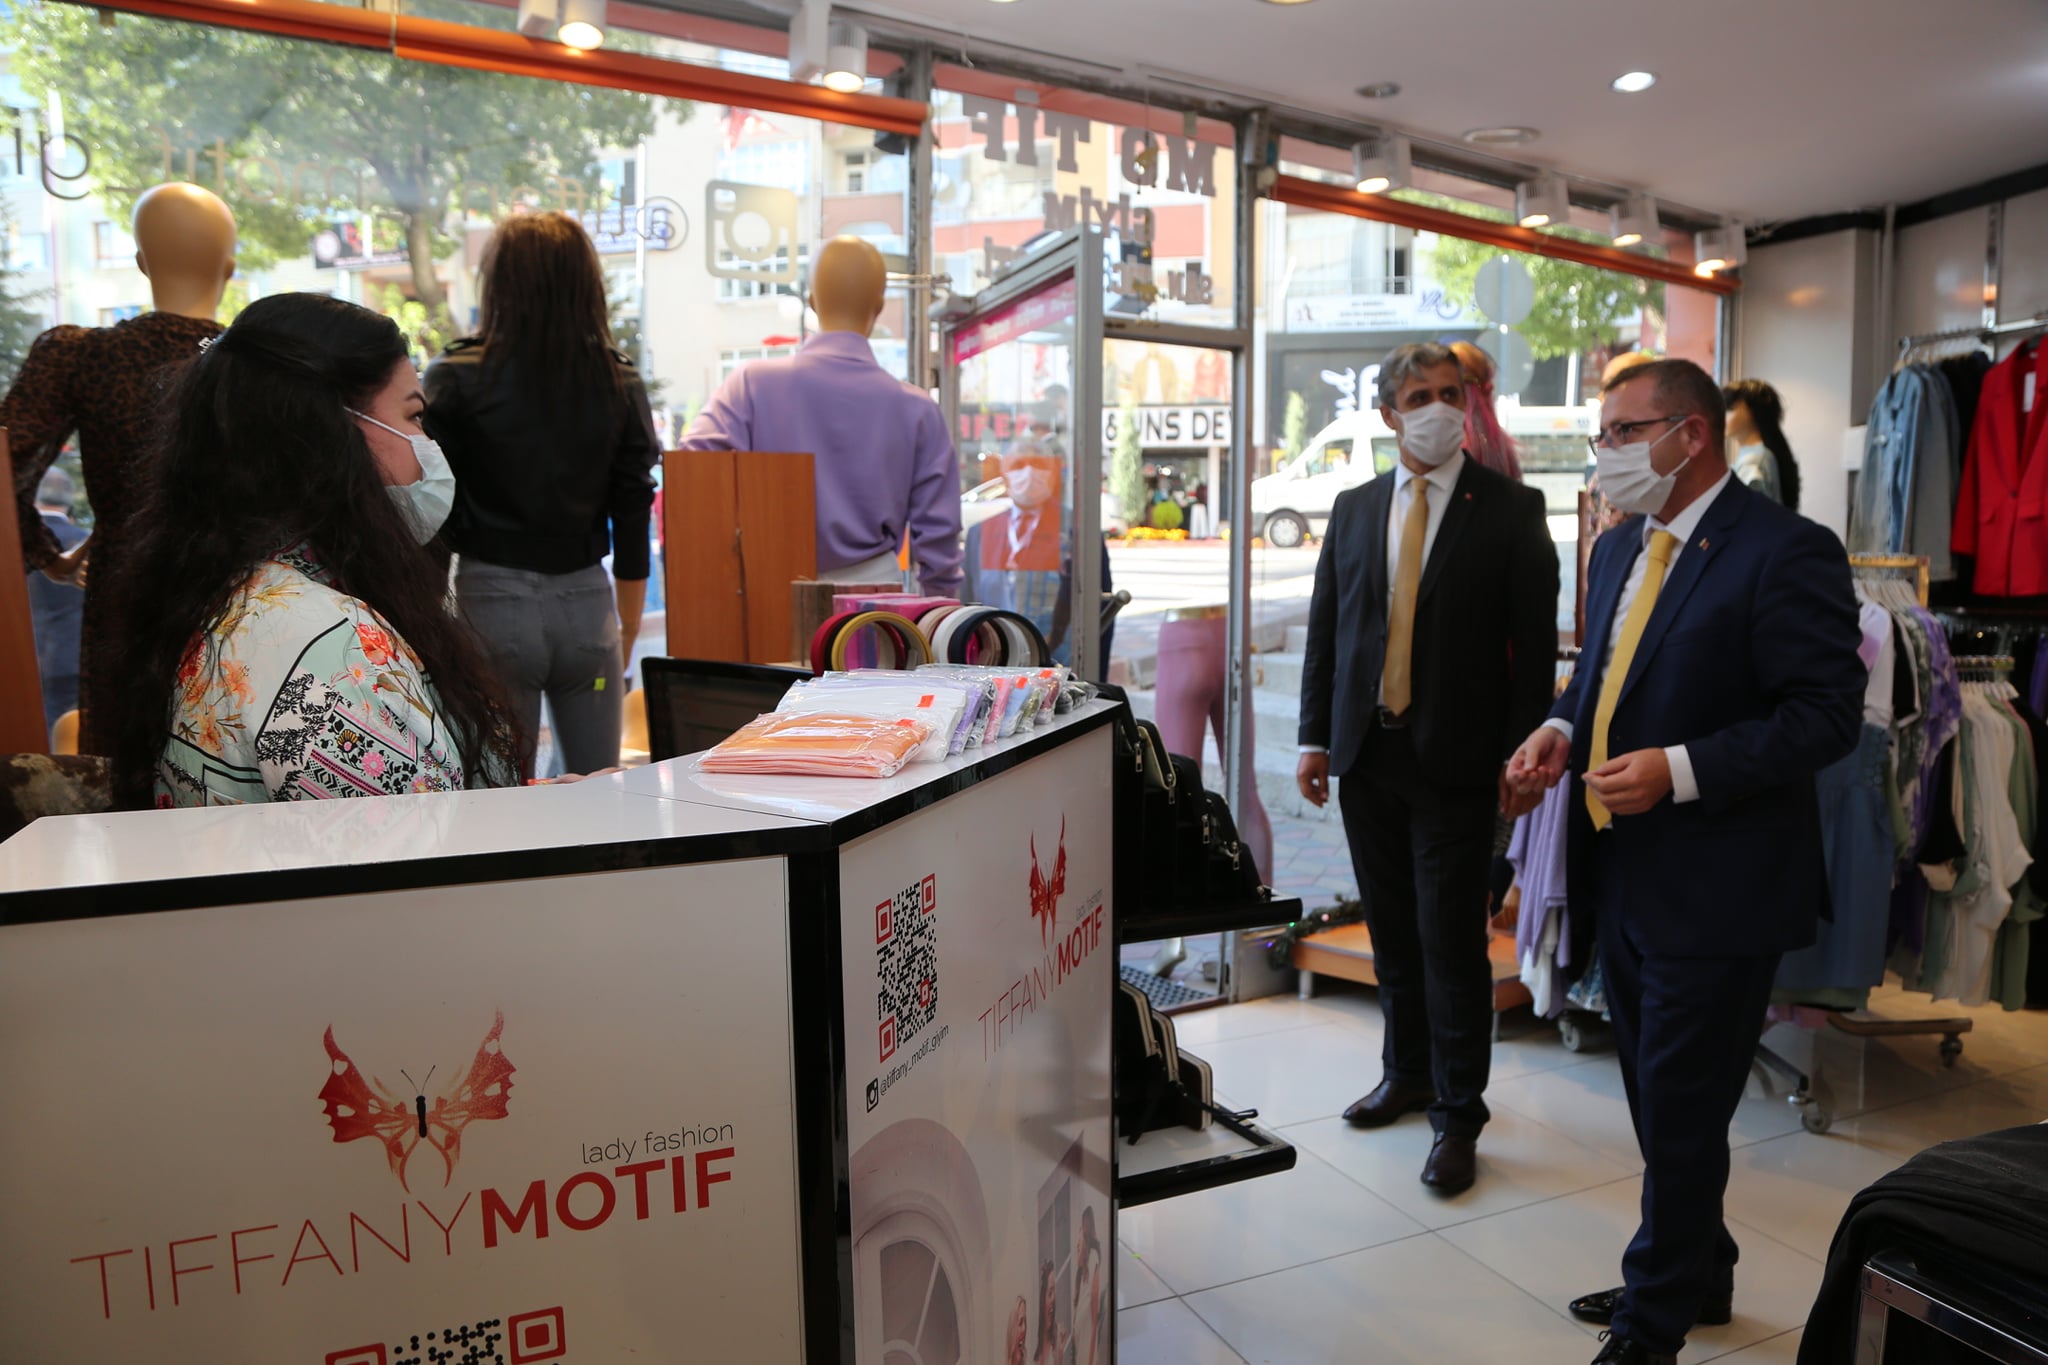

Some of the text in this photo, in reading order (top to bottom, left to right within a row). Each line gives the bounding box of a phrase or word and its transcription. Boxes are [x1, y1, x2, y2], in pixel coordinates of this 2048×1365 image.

[1192, 410, 1232, 441] DE
[582, 1122, 735, 1165] lady fashion
